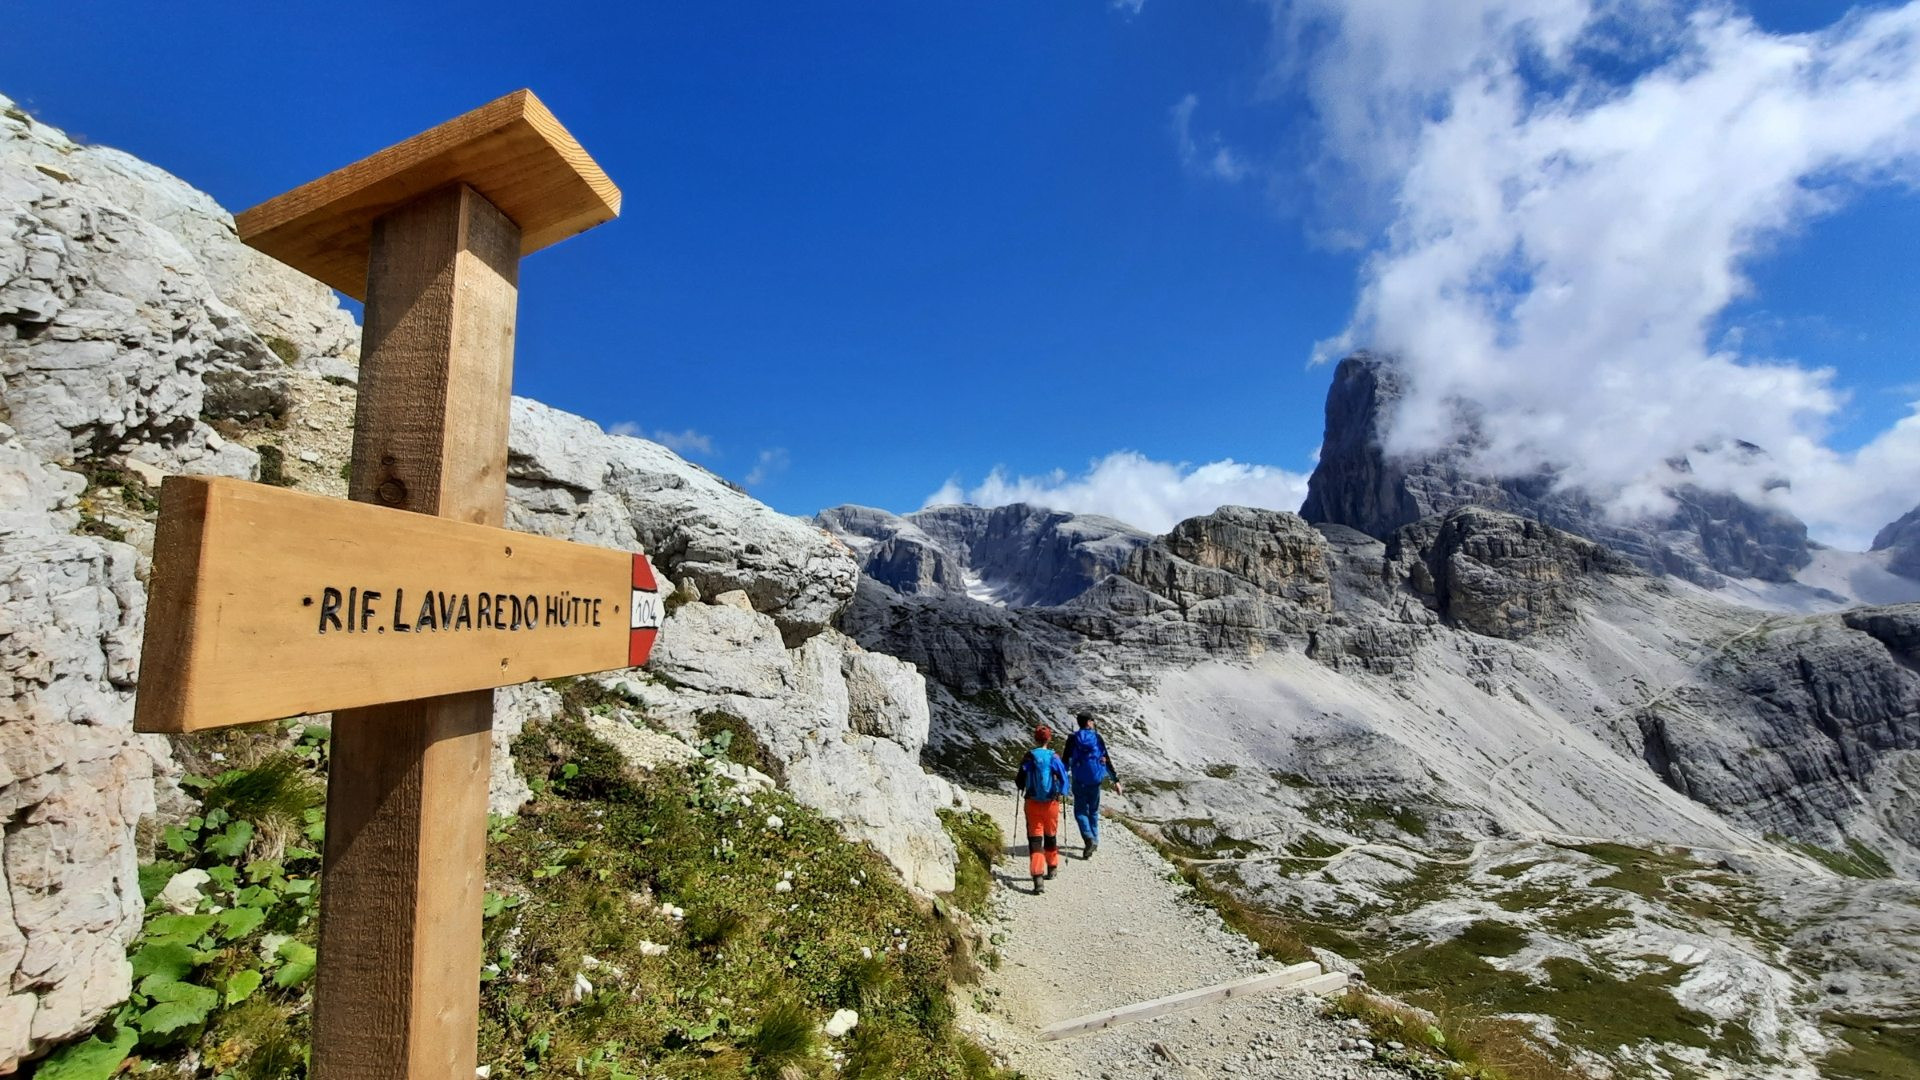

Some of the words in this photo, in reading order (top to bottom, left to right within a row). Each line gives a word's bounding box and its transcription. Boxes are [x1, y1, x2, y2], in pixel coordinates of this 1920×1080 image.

[393, 587, 539, 633] LAVAREDO
[545, 590, 602, 628] HÜTTE
[636, 596, 657, 627] 104
